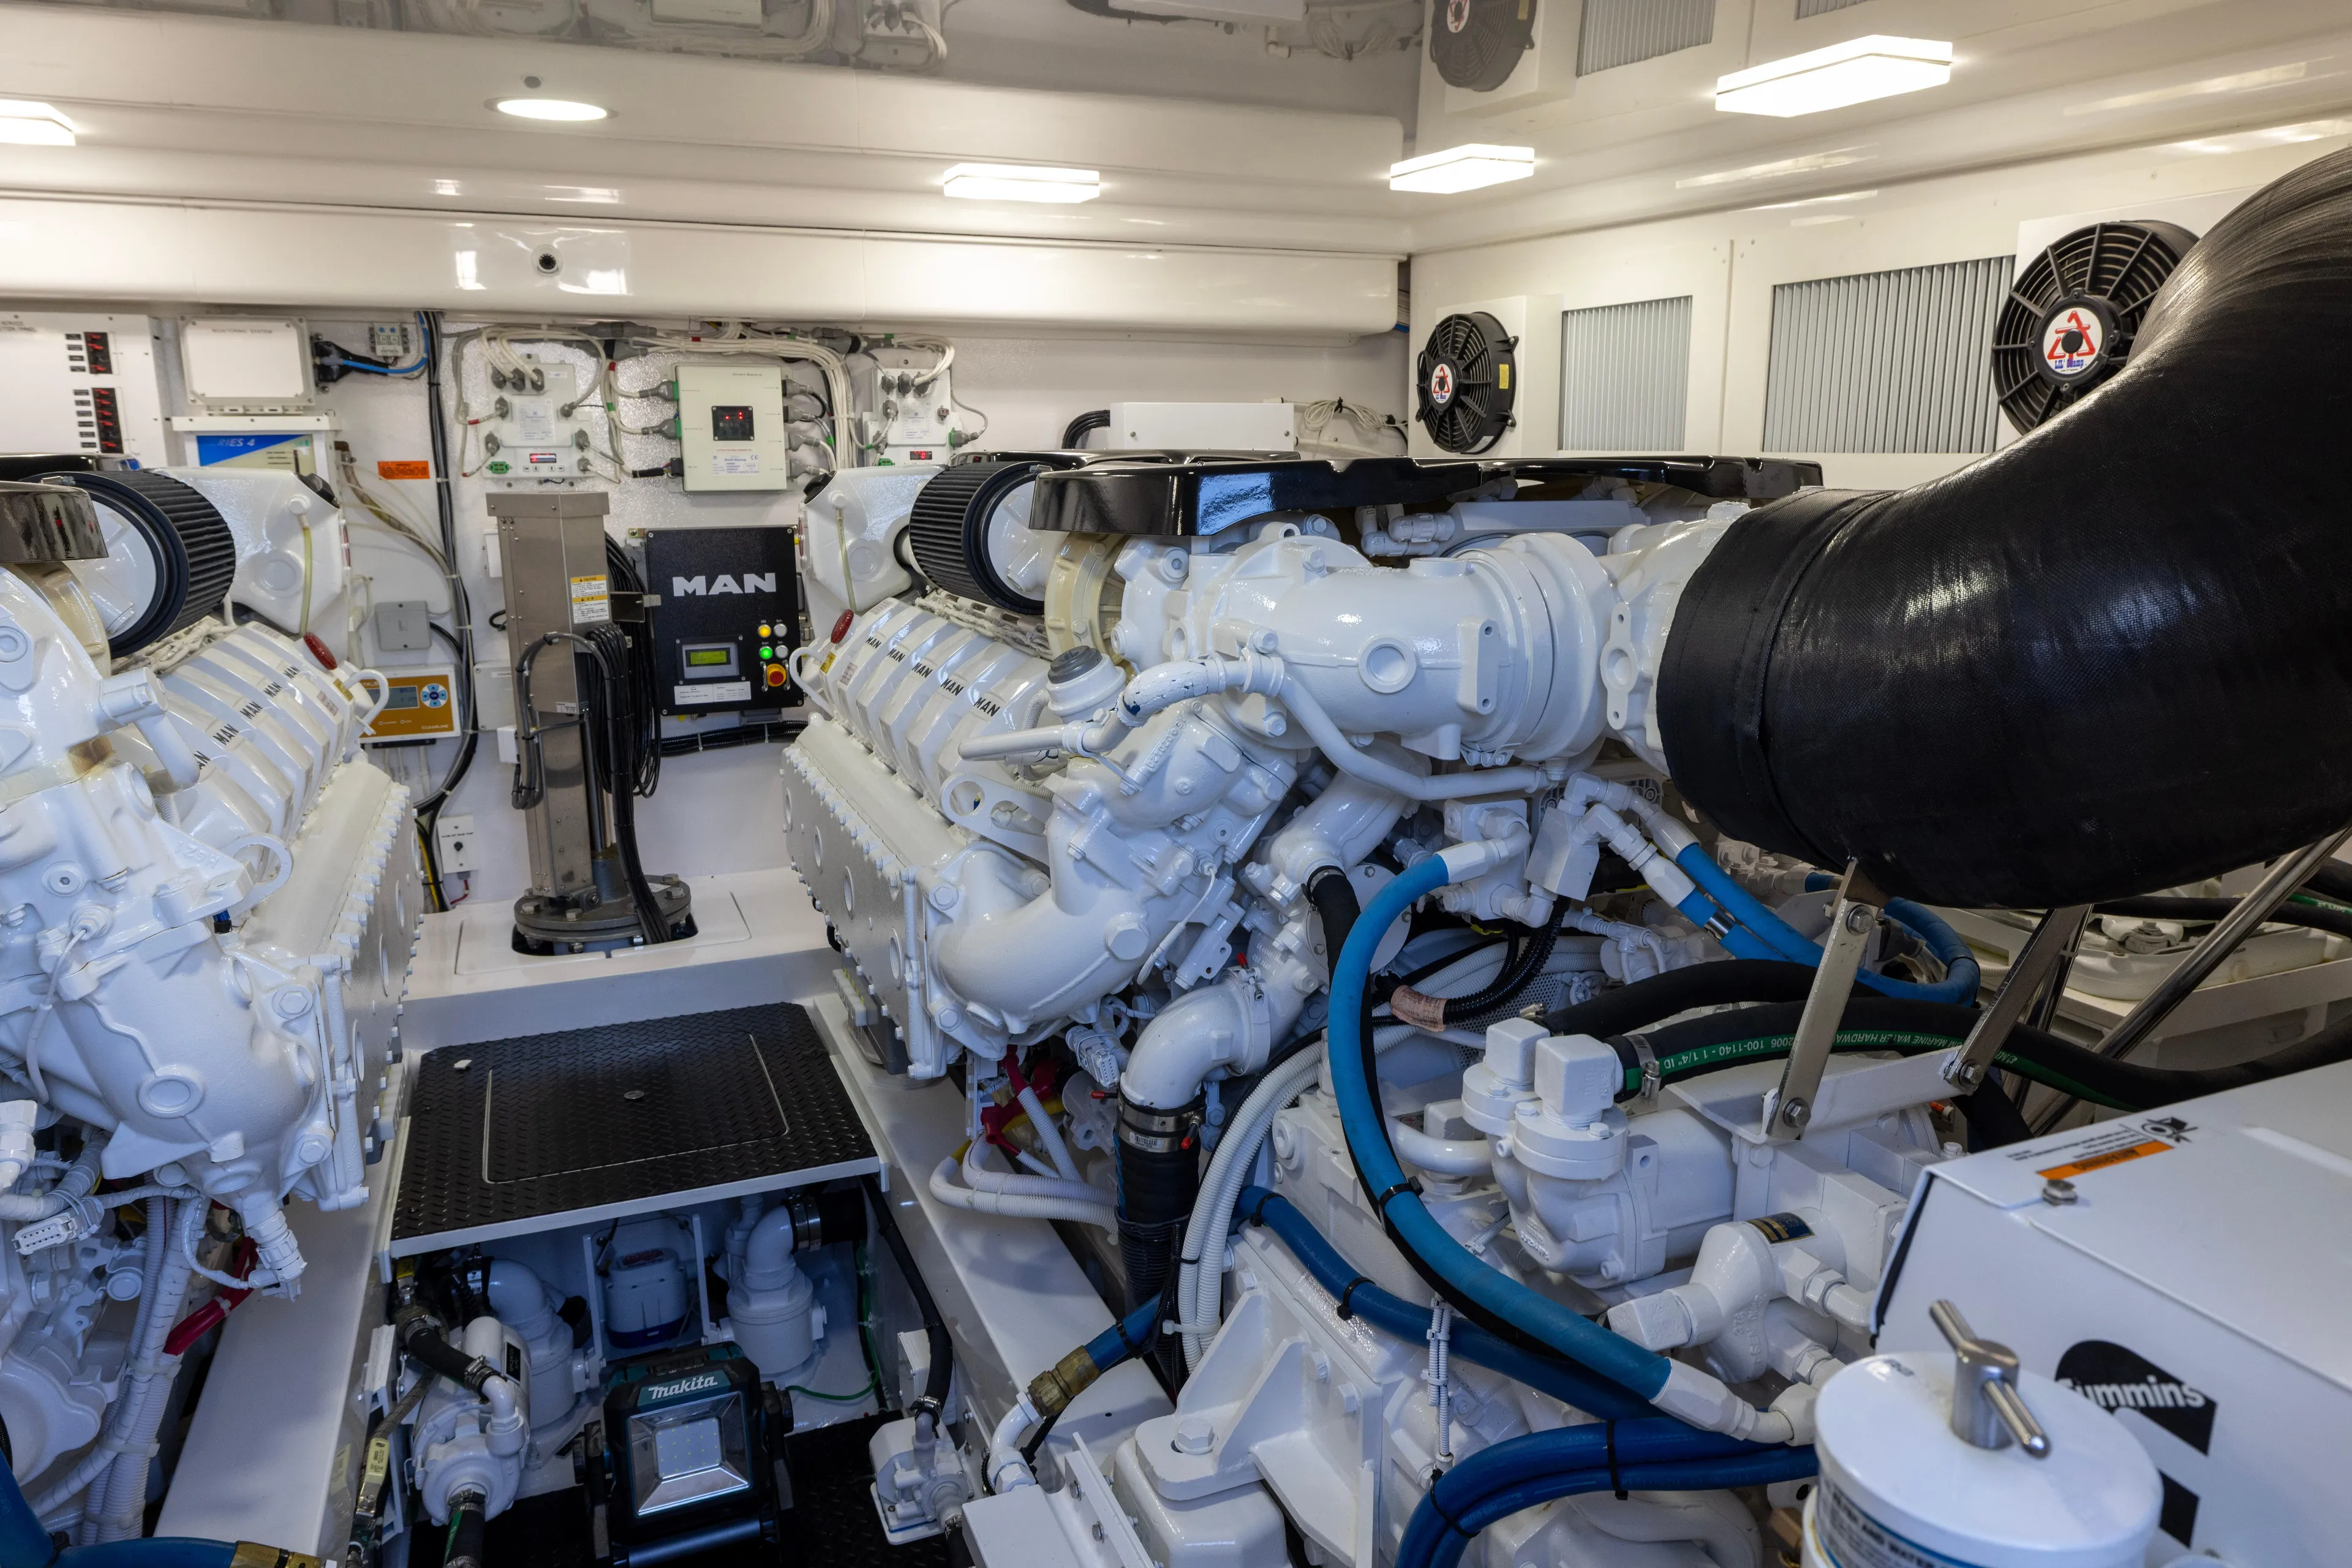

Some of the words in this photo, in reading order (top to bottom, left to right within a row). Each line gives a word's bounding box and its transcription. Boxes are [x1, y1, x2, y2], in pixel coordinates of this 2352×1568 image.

[673, 573, 777, 597] MAN
[865, 636, 881, 649] MAN
[887, 648, 905, 663] MAN
[283, 665, 300, 679] MAN
[912, 662, 933, 678] MAN
[263, 682, 283, 698] MAN
[940, 678, 964, 696] MAN
[239, 701, 263, 719] MAN
[973, 698, 1000, 717] MAN
[213, 723, 239, 745] MAN
[194, 750, 210, 770] AN
[1719, 1040, 1764, 1056] 100-1140
[1914, 1035, 1948, 1048] MARINE
[1664, 1058, 1675, 1069] ID
[648, 1376, 718, 1401] makita
[2059, 1374, 2206, 1408] ummins
